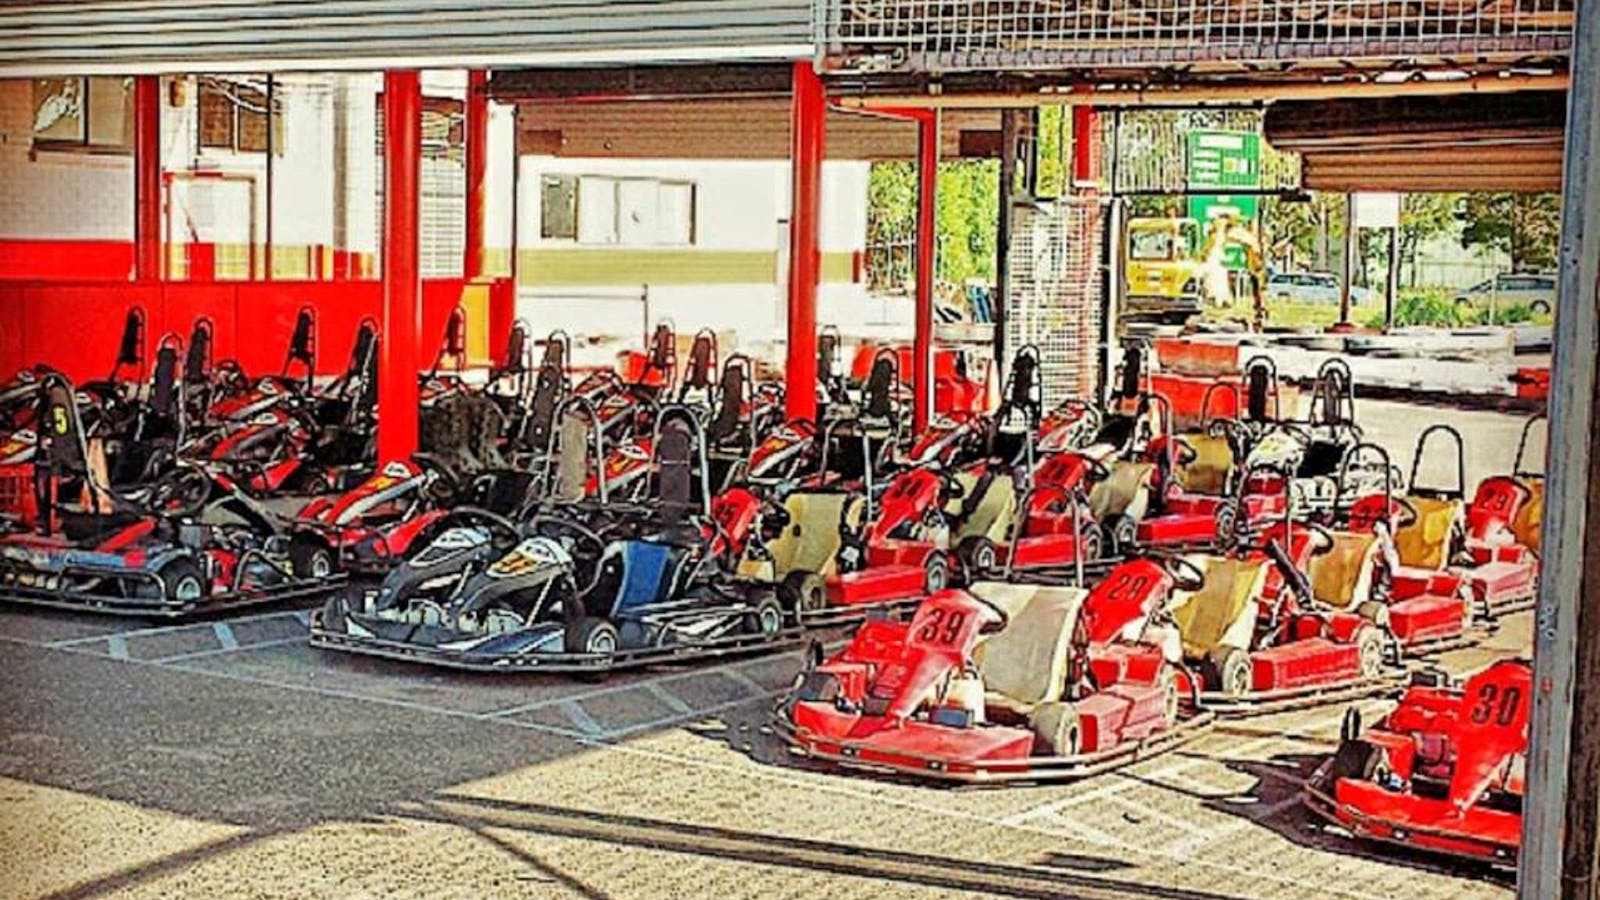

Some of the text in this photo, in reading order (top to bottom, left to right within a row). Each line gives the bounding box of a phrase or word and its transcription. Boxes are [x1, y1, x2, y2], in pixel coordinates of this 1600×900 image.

[53, 407, 67, 434] 5
[922, 607, 964, 644] 39
[1472, 684, 1520, 726] 30
